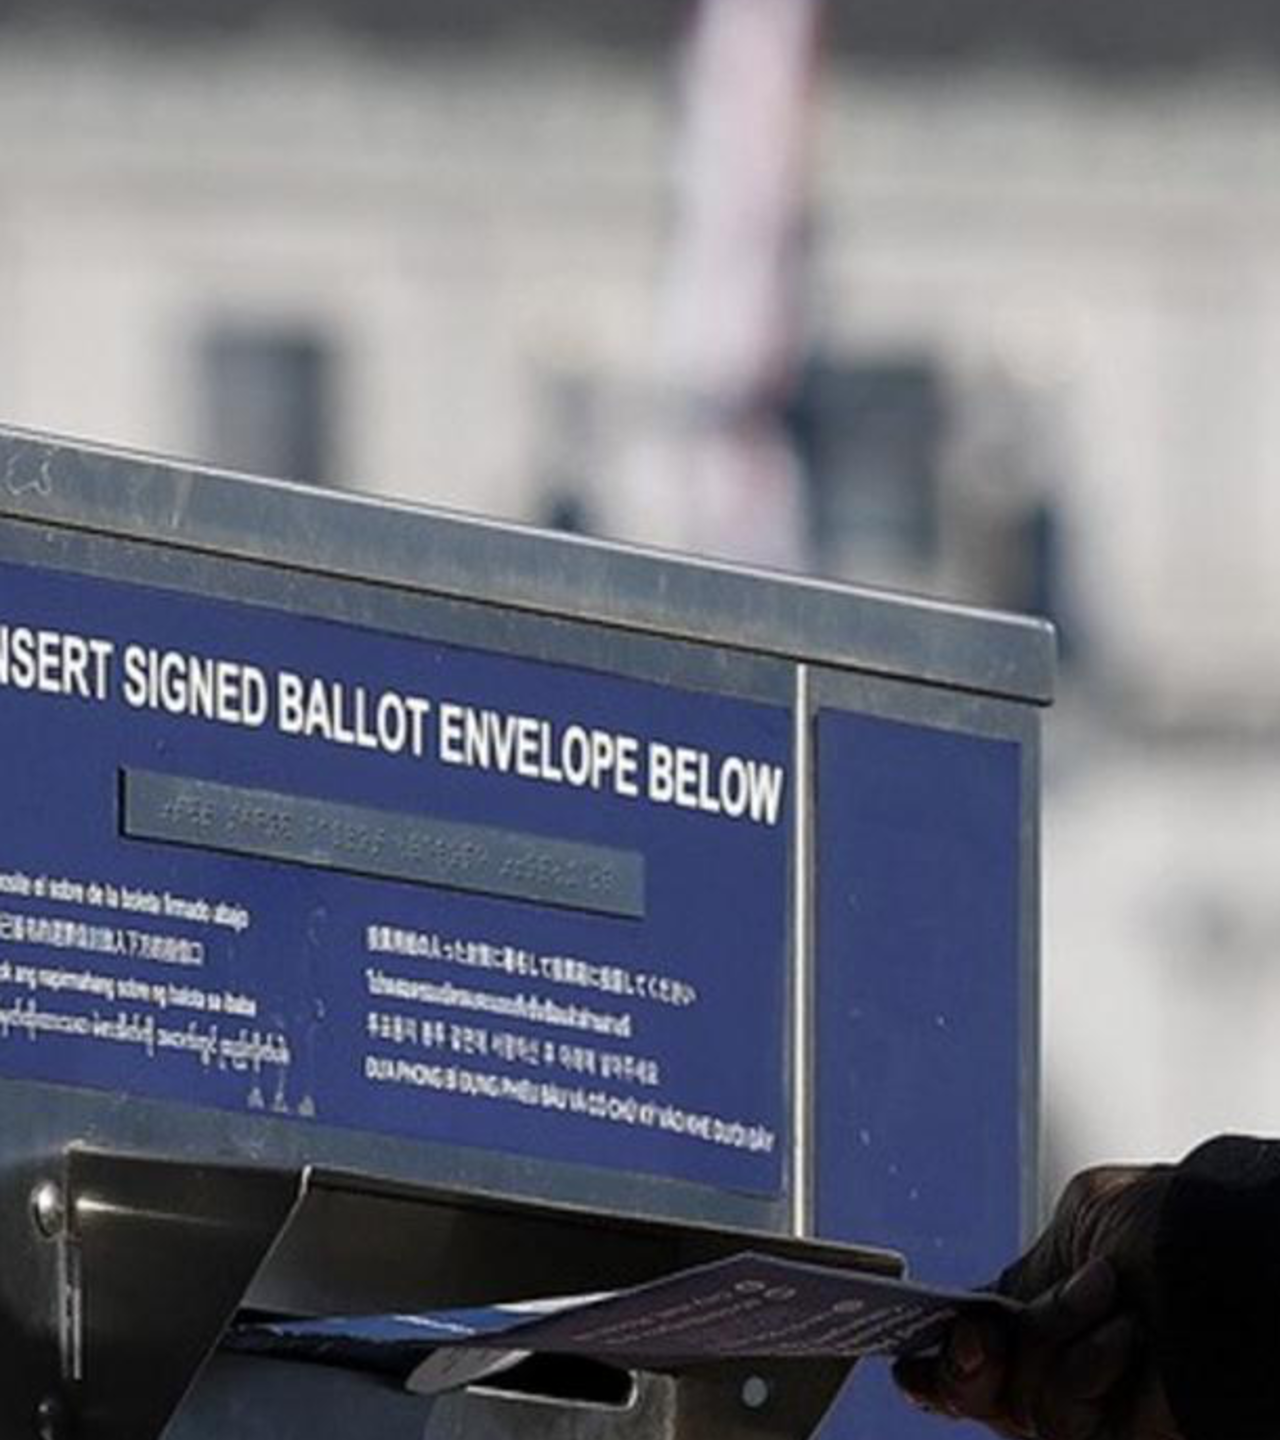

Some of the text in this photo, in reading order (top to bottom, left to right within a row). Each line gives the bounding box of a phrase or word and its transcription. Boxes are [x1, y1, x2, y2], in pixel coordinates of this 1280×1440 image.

[123, 644, 268, 728] SIGNED
[278, 671, 430, 757] BALLOT
[439, 703, 638, 797] ENVELOPE
[648, 742, 784, 826] BELOW
